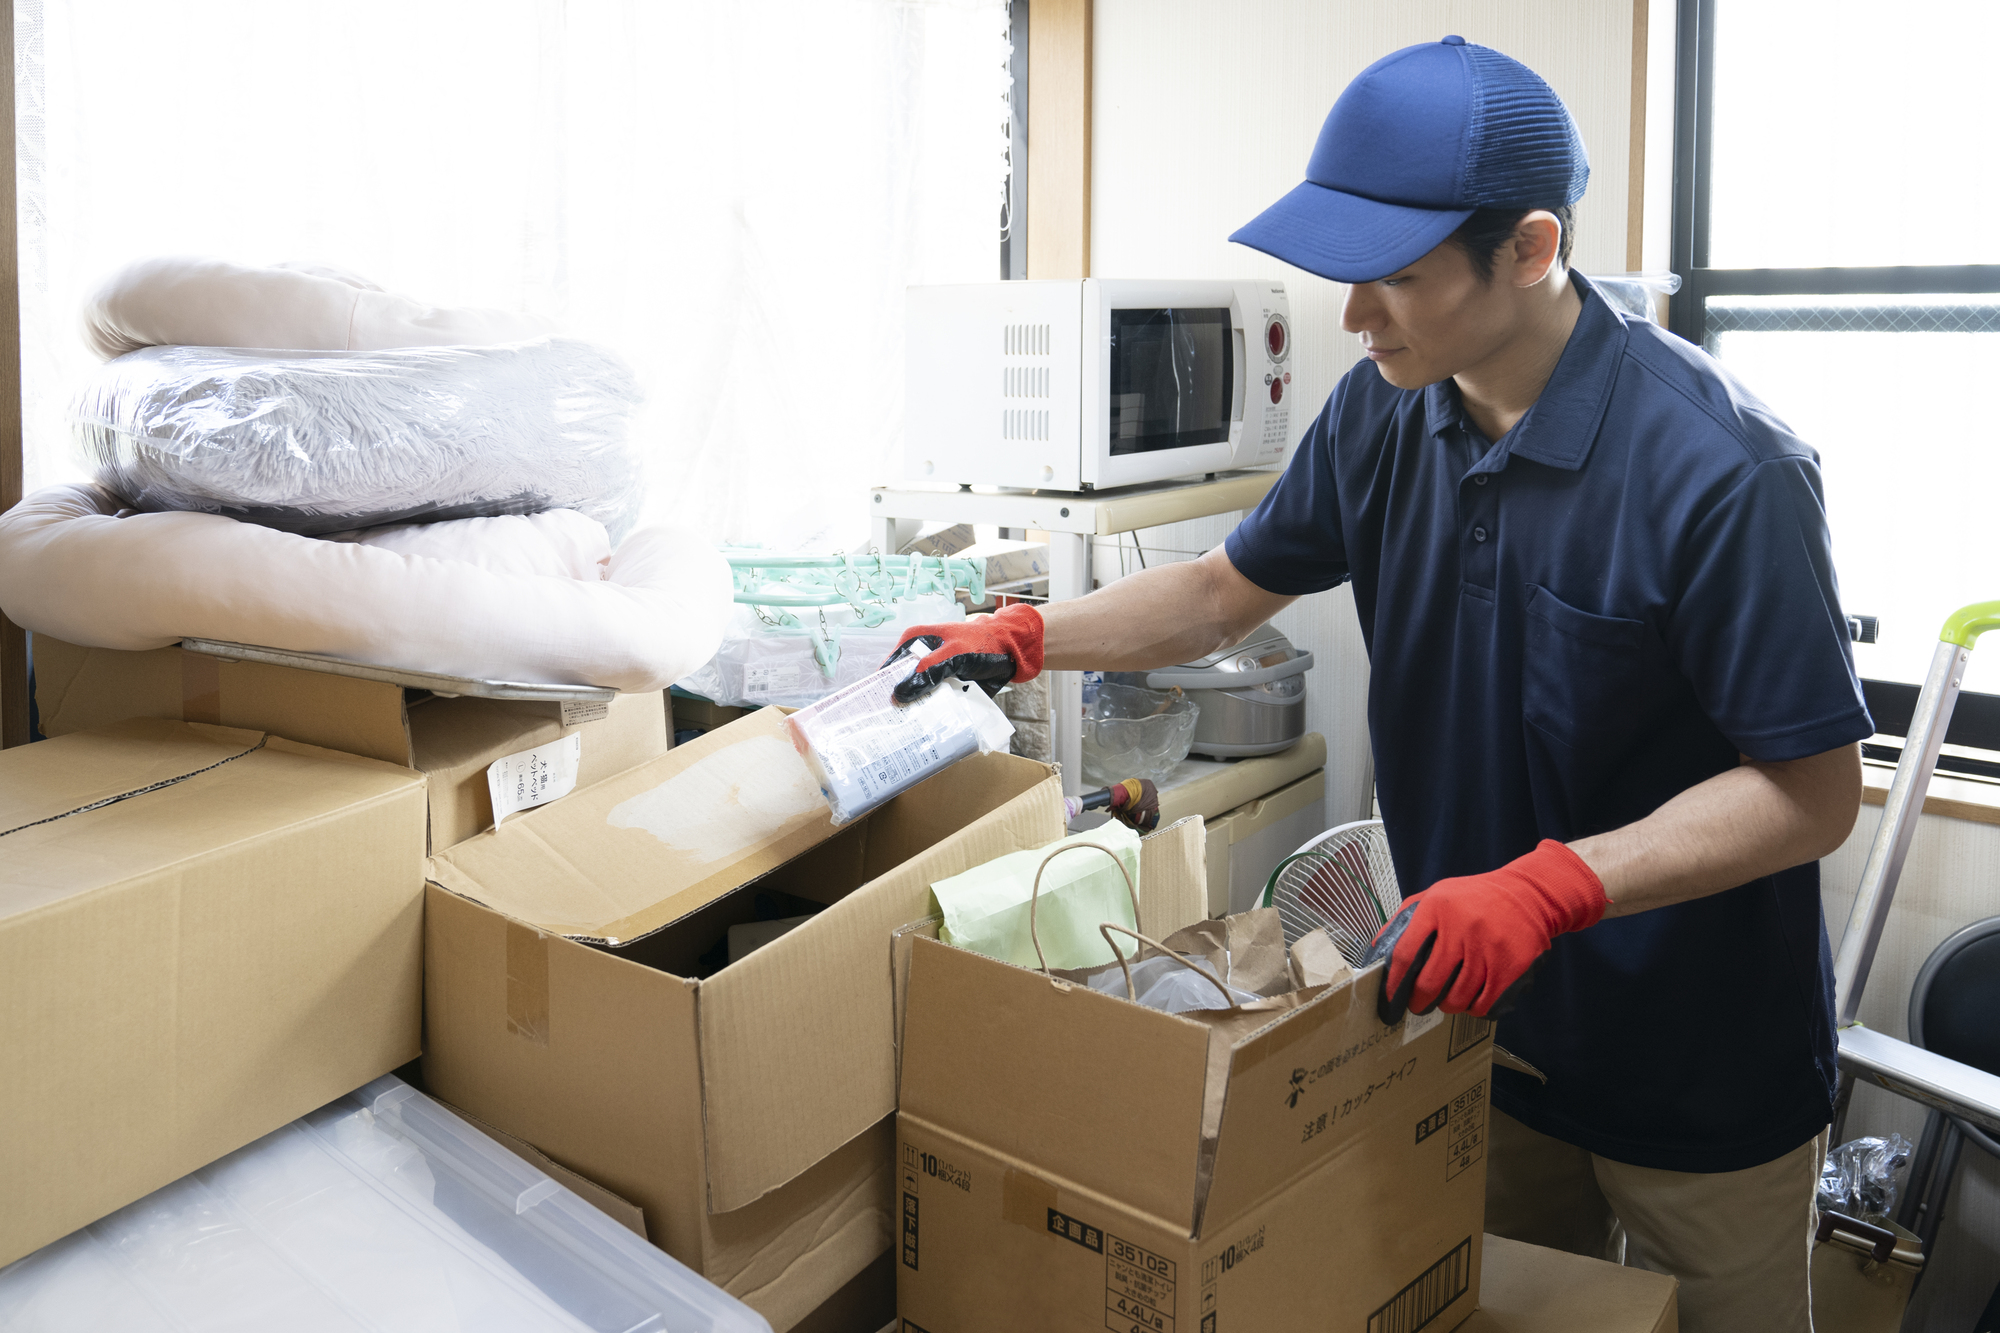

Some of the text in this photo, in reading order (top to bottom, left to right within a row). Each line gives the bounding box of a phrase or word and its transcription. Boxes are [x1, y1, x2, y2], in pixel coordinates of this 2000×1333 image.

[1453, 1084, 1483, 1114] 35102
[1418, 1109, 1446, 1139] 企画品
[905, 1196, 917, 1267] 落下厳禁
[1051, 1213, 1099, 1249] 企画品
[1113, 1241, 1169, 1277] 35102
[1109, 1259, 1173, 1293] ニャンとも清潔トイレ
[1124, 1286, 1157, 1308] 大きめの粒
[1117, 1298, 1164, 1330] 4.4L/袋
